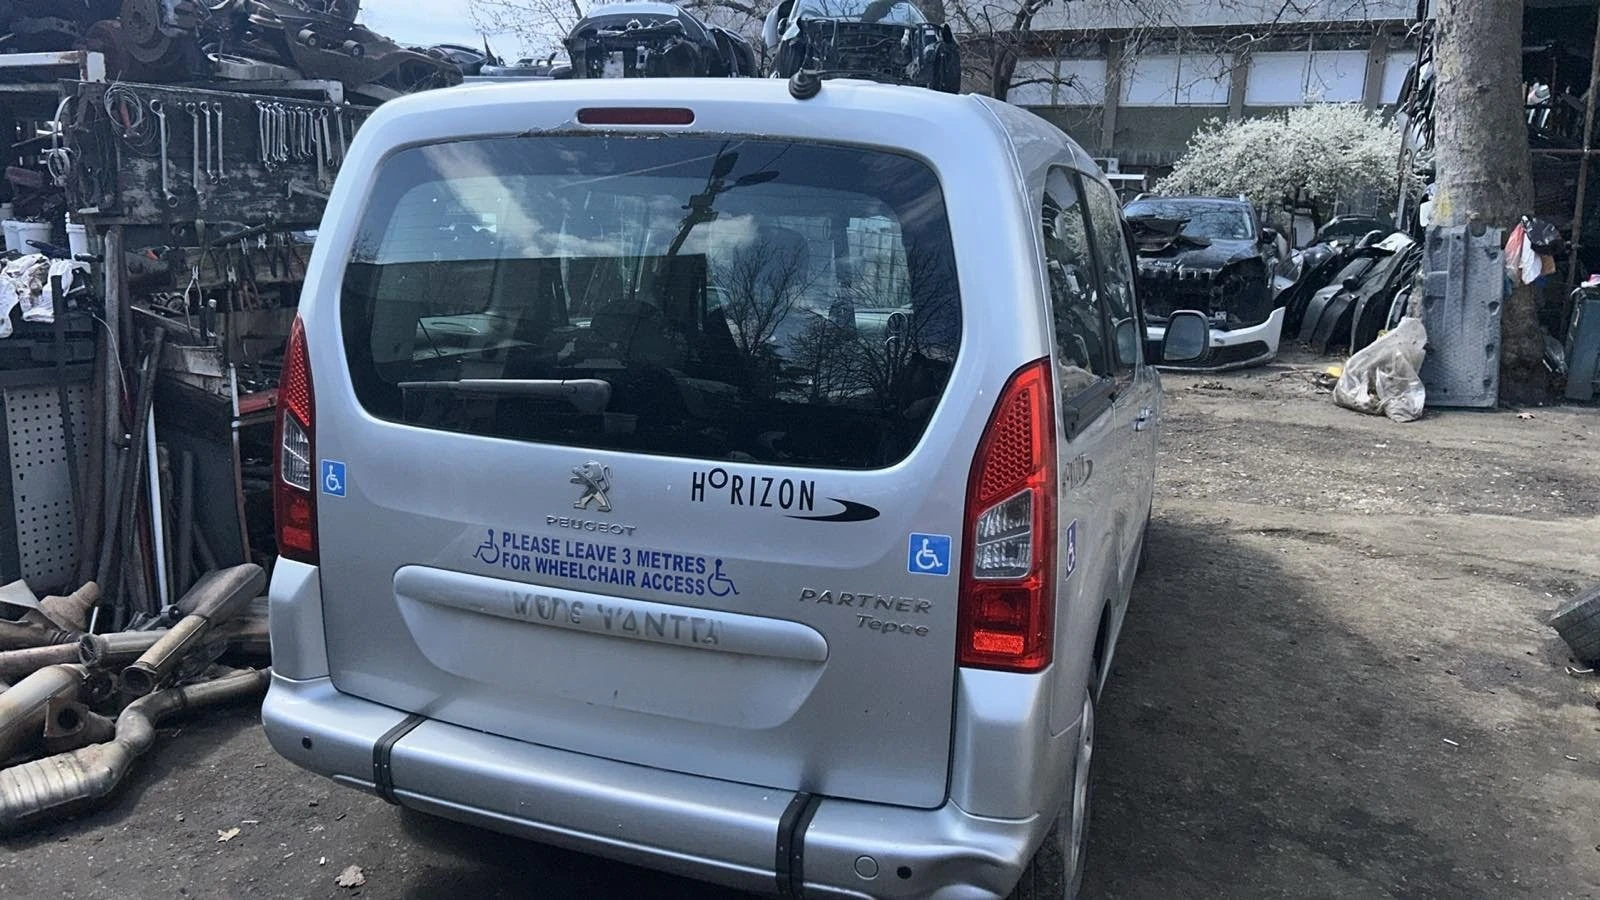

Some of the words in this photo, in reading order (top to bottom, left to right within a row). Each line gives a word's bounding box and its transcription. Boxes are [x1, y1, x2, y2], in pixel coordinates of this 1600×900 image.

[691, 468, 815, 511] HORIZON
[546, 515, 637, 537] PEUGEOT
[502, 532, 560, 555] PLEASE
[566, 540, 617, 564] LEAVE
[622, 548, 631, 565] 3
[637, 550, 706, 574] METRES
[502, 551, 530, 571] FOR
[535, 558, 636, 587] WHEELCHAIR
[641, 573, 705, 596] ACCESS
[800, 587, 932, 613] PARTNER
[857, 613, 929, 636] Tepee
